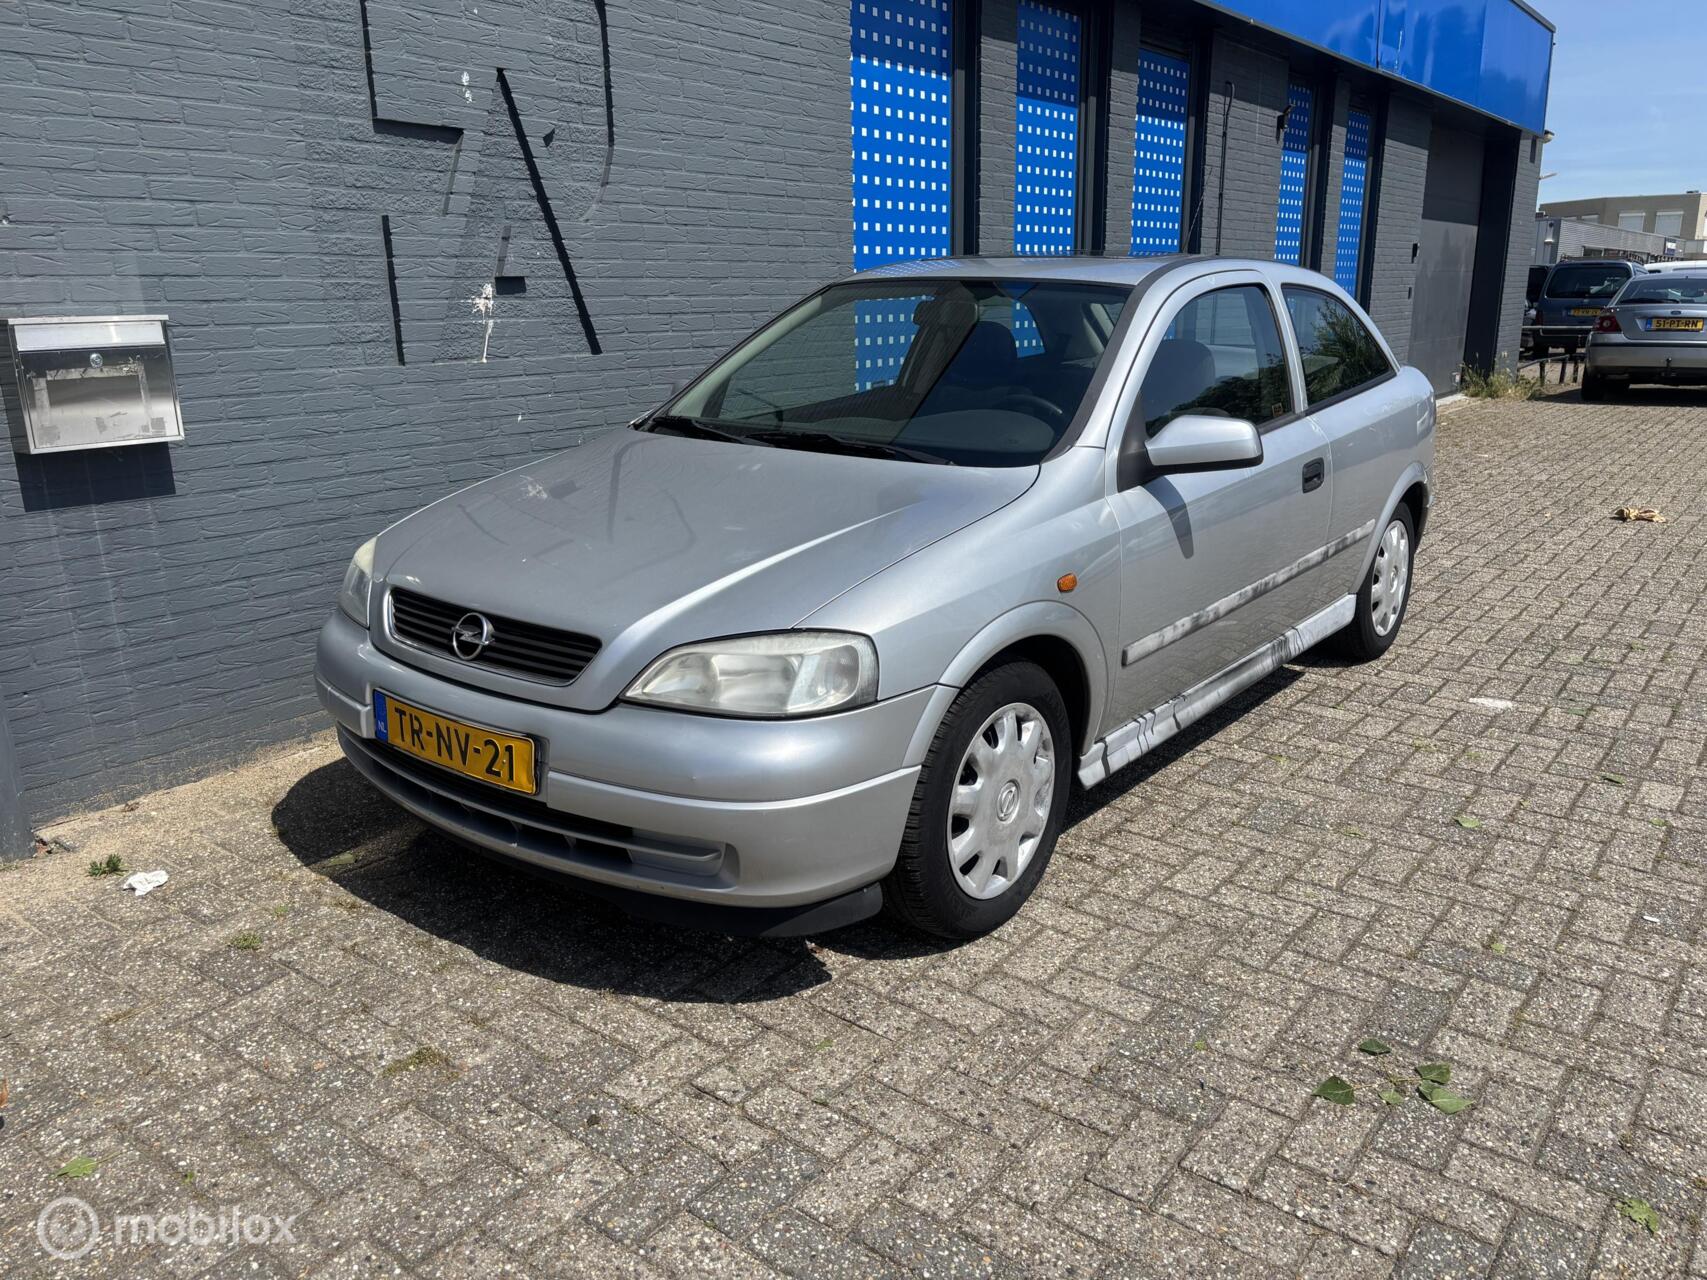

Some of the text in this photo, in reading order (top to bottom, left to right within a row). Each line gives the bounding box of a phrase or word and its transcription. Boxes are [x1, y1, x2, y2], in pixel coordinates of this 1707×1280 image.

[1655, 319, 1699, 328] 51-PT-RN
[377, 720, 388, 734] NL
[394, 706, 516, 783] TR-NV-21
